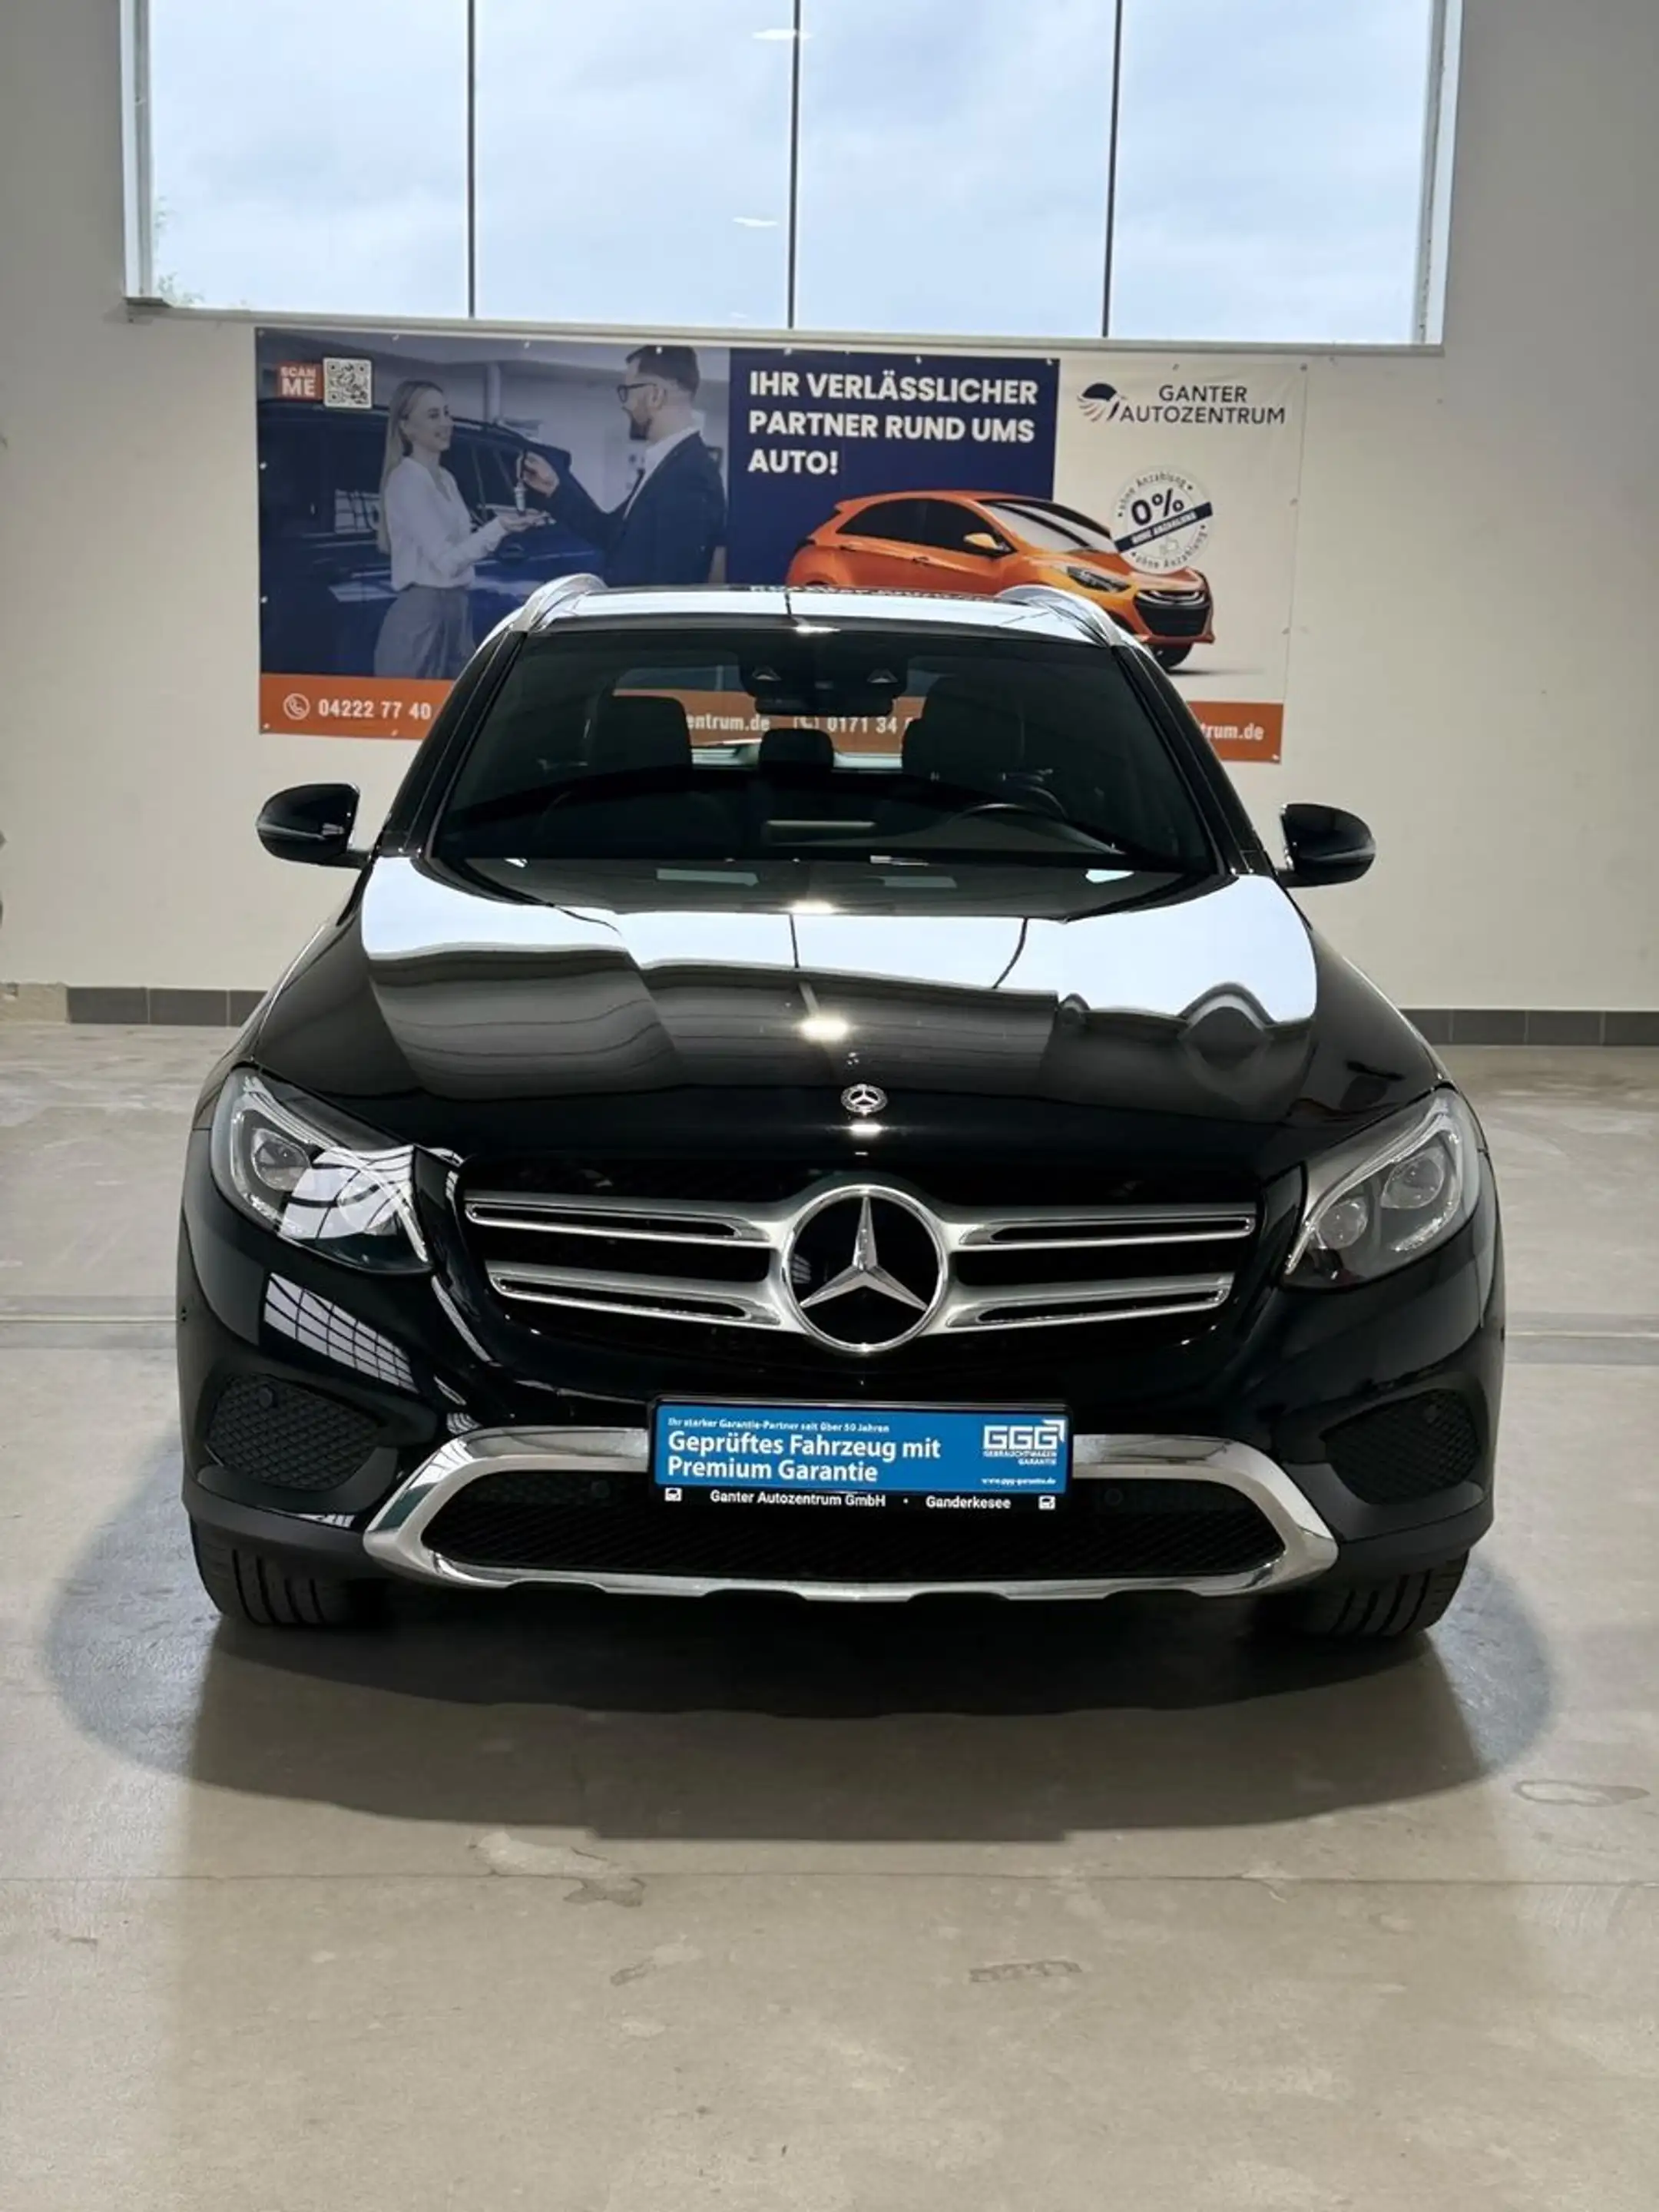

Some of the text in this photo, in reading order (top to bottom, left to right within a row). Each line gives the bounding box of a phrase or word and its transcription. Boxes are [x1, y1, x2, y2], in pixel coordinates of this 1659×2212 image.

[280, 366, 316, 377] SCAN
[282, 377, 315, 397] ME
[750, 369, 1039, 405] IHR VERLÄSSLICHER
[1158, 384, 1248, 403] GANTER
[1120, 406, 1286, 425] AUTOZENTRUM
[749, 411, 1035, 443] PARTNER RUND UMS
[747, 448, 839, 475] AUTO!
[1131, 487, 1185, 526] 0%
[318, 698, 432, 720] 04222 77 40
[687, 714, 770, 731] entrum.de
[826, 716, 869, 733] 0171
[876, 716, 897, 734] 34
[801, 1422, 819, 1432] seit
[857, 1422, 890, 1434] Jahren
[983, 1426, 1058, 1450] GGG
[668, 1430, 942, 1463] Geprüftes Fahrzeug mit
[667, 1455, 879, 1483] Premium Garantie
[710, 1488, 1012, 1510] Ganter Autozentrum GmbH Ganderkesee
